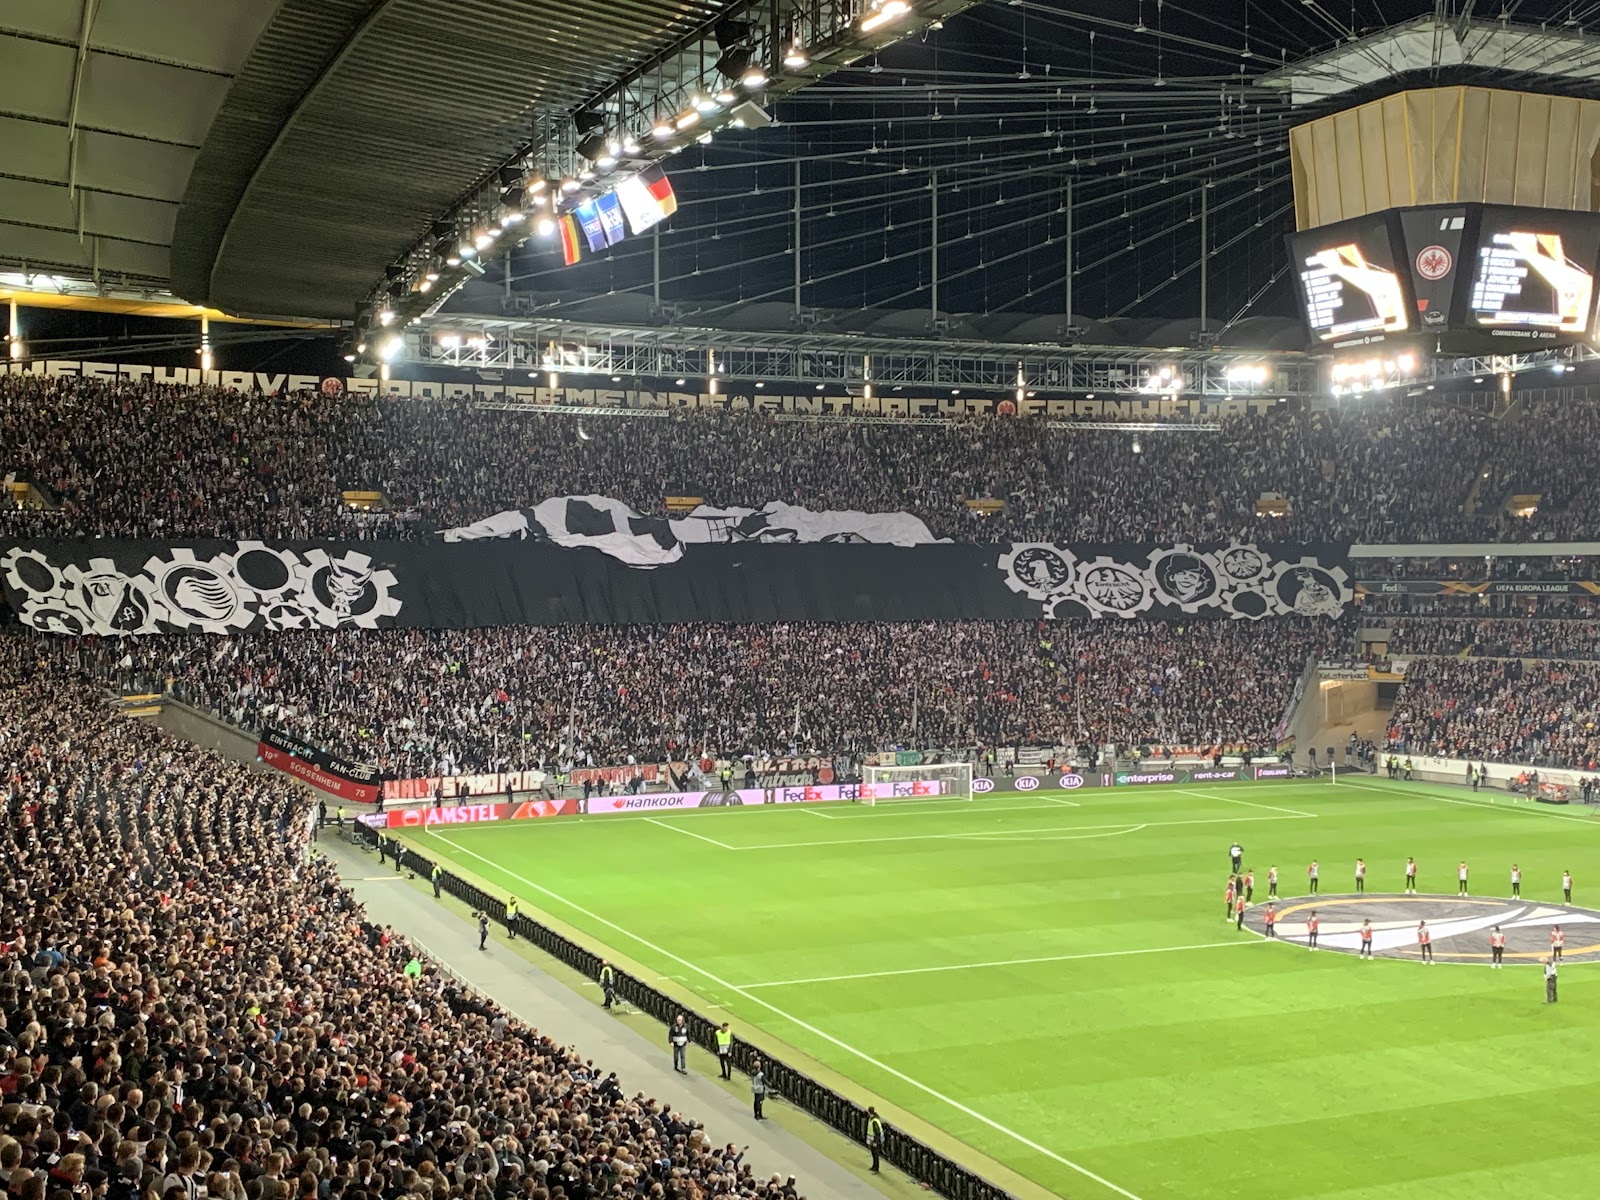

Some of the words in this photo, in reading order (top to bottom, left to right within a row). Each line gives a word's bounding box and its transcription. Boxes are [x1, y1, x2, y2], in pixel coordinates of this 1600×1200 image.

[1491, 330, 1531, 338] COMMERZBANK
[269, 733, 315, 760] EINTRACHT
[330, 761, 371, 781] FAN-CLUB
[289, 761, 341, 791] SOSSENHEIM
[355, 788, 365, 798] 75
[1018, 779, 1036, 789] KIA
[1062, 777, 1080, 786] KIA
[1116, 773, 1174, 784] enterprise
[1194, 771, 1236, 780] rent-a-car
[893, 780, 930, 796] FedEx
[972, 781, 991, 791] KIA
[783, 786, 823, 802] FedEx
[427, 804, 499, 825] AMSTEL
